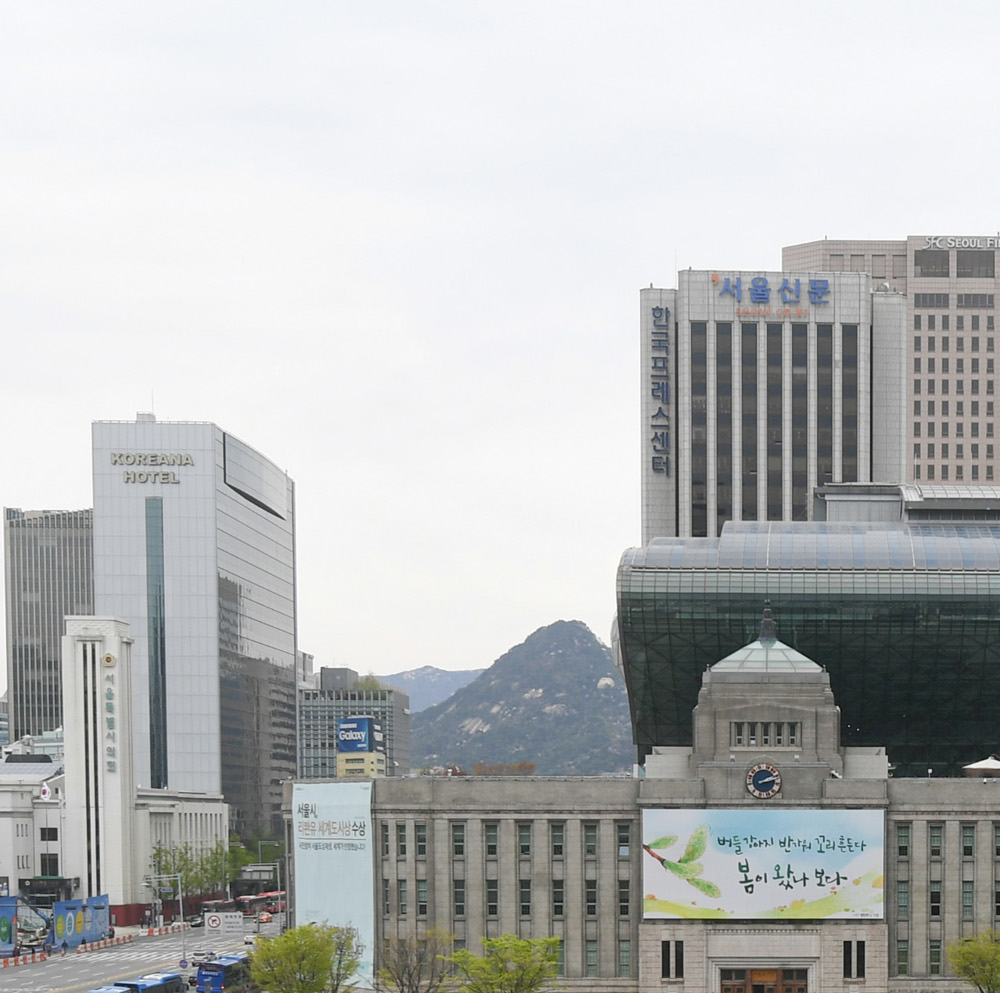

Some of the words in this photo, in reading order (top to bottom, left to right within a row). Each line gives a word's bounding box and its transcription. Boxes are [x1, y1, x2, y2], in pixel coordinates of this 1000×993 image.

[947, 237, 983, 248] SEOUL
[719, 276, 831, 304] 서울신문
[736, 305, 808, 318] seoul.co.kr
[651, 306, 671, 477] 한국프레스센터
[110, 452, 194, 466] KOREANA
[123, 471, 180, 484] HOTEL
[104, 673, 116, 773] 서울특별시의회
[339, 730, 366, 742] Galaxy
[717, 835, 774, 855] 버들강아지
[779, 836, 812, 853] 반가워
[738, 858, 768, 894] 봄이
[772, 864, 809, 890] 왔나
[815, 868, 848, 887] 보다
